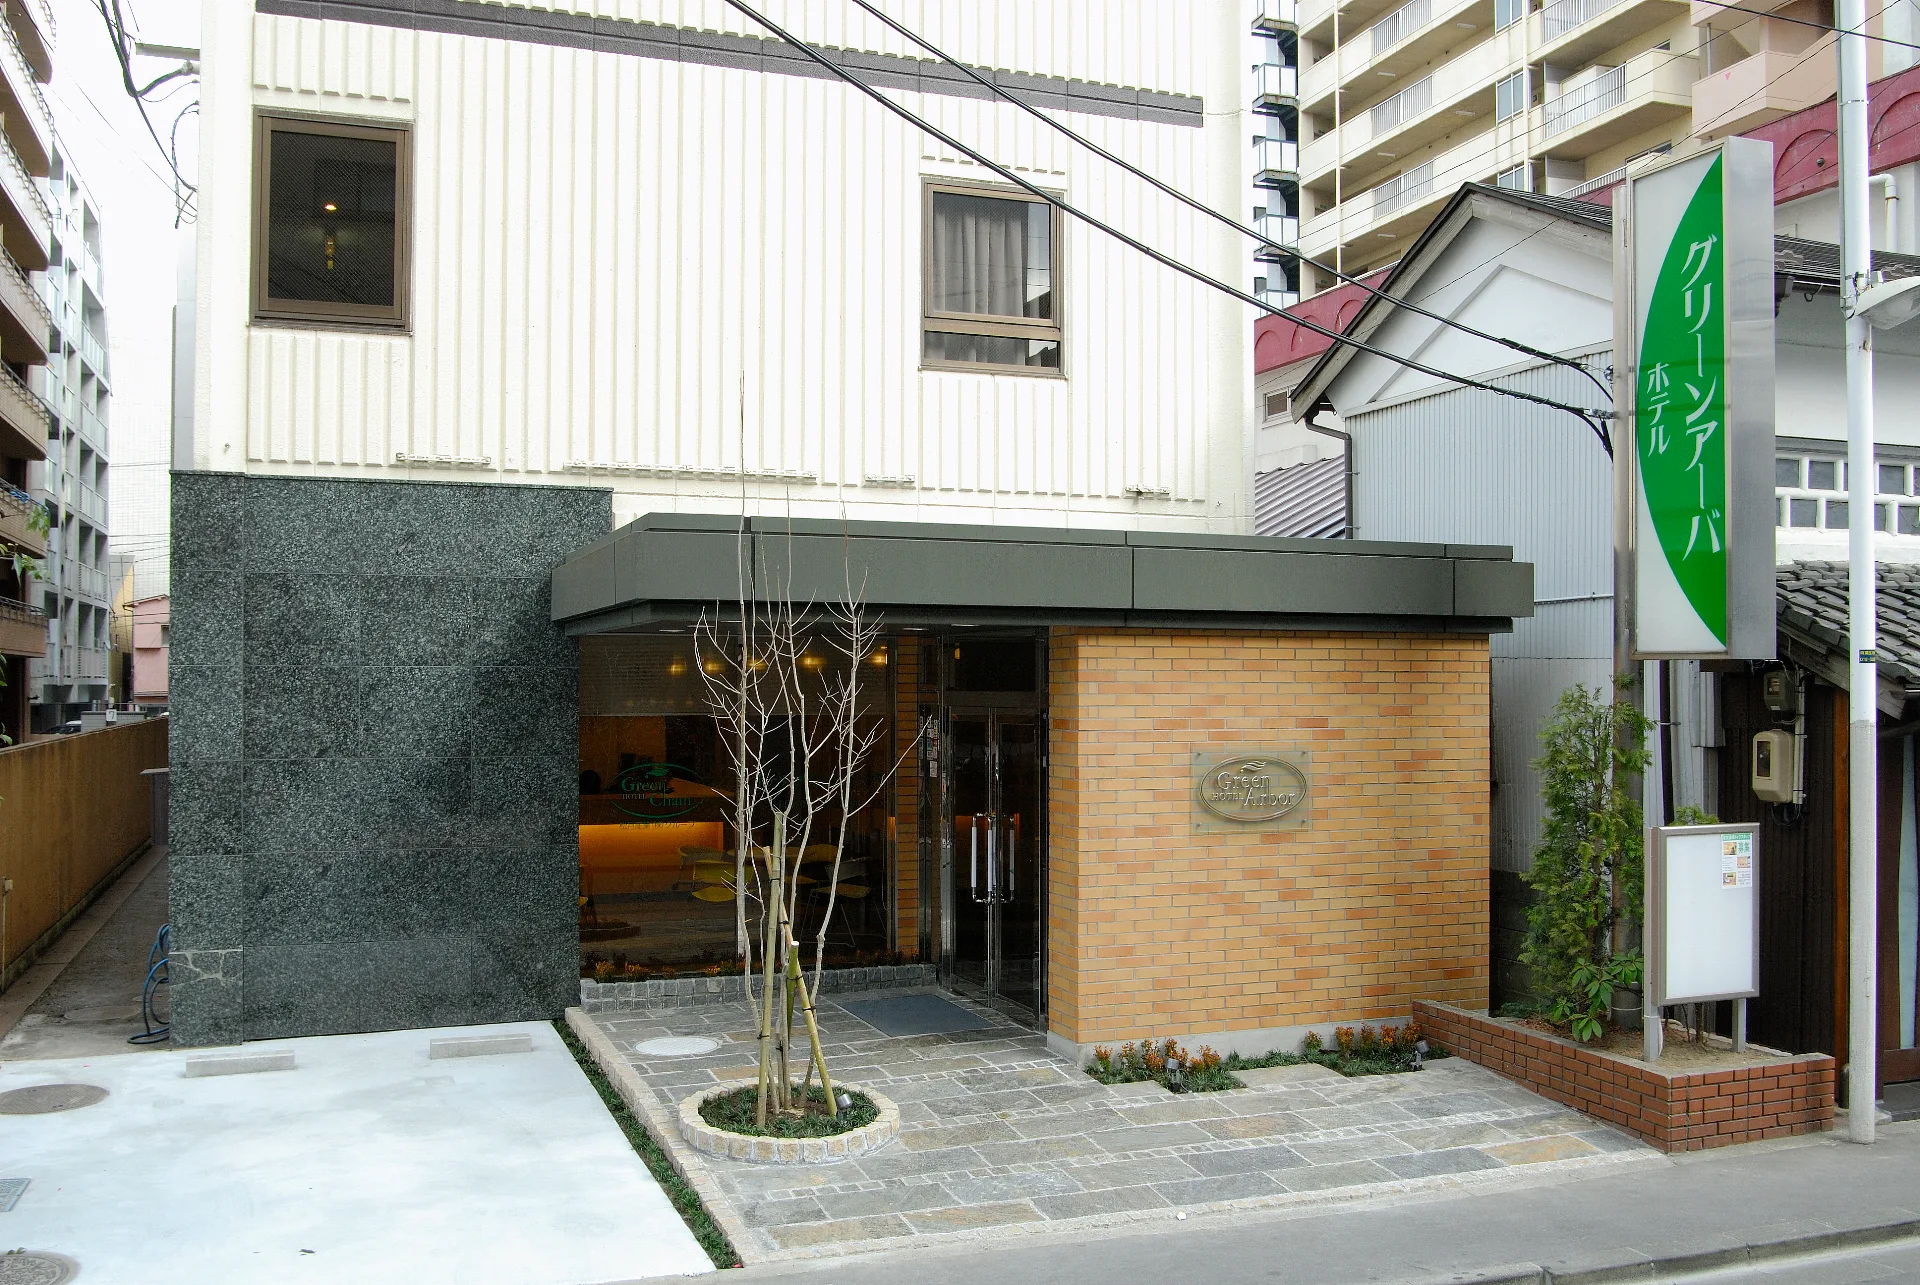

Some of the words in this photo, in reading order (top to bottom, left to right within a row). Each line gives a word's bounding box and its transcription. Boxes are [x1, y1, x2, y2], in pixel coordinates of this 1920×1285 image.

[1679, 233, 1720, 563] グリーンアーバ
[1646, 361, 1671, 458] ホテル
[621, 776, 668, 792] Green
[1217, 771, 1270, 790] Green
[649, 789, 692, 807] Chain
[1210, 792, 1244, 802] HOTEL
[1243, 786, 1296, 807] Arbor
